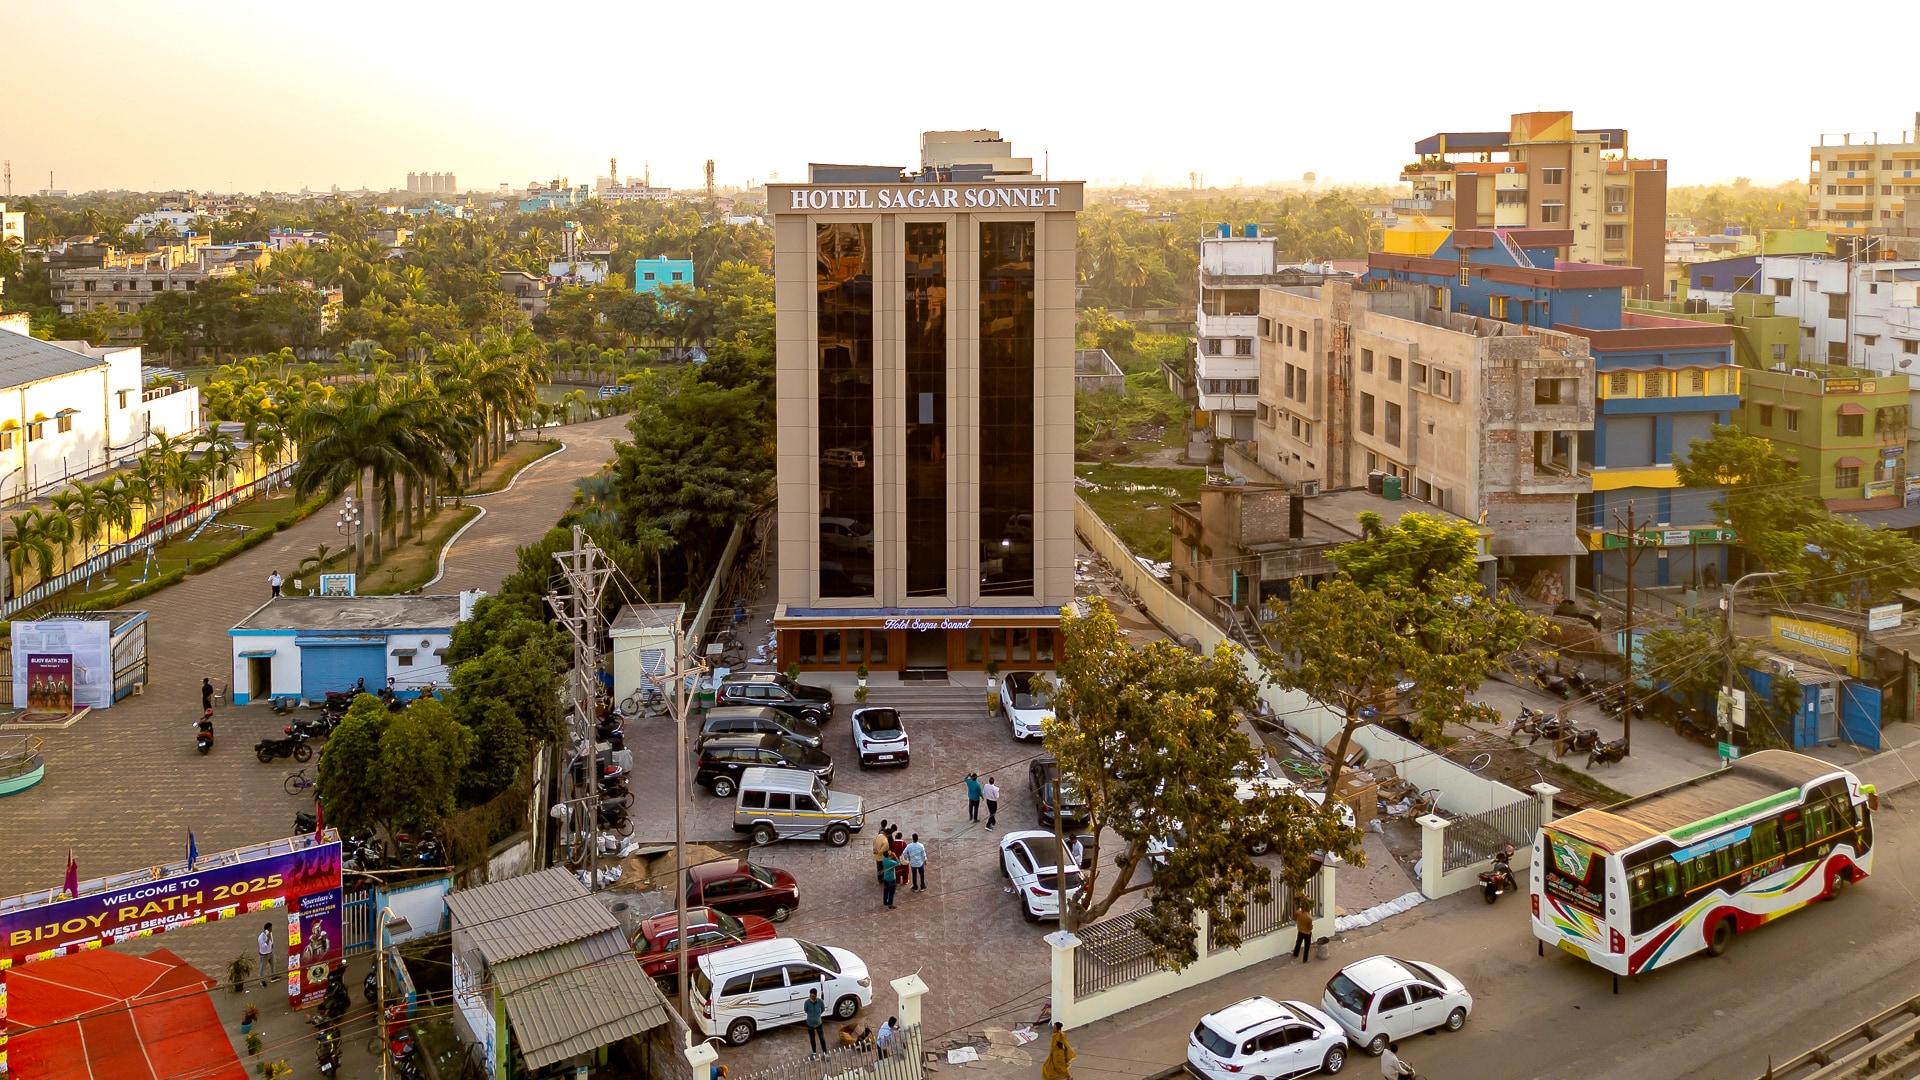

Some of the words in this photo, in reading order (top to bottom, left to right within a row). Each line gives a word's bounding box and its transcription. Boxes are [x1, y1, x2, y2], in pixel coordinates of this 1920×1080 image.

[790, 190, 874, 209] HOTEL
[878, 187, 960, 208] SAGAR
[964, 187, 1060, 207] SONNET
[883, 618, 910, 630] Hotel
[911, 617, 938, 632] Sagar
[940, 617, 972, 630] Sonnet
[103, 882, 177, 907] WELCOME
[180, 878, 200, 891] TO
[300, 892, 334, 908] Spartan's
[9, 911, 109, 947] BIJOY
[118, 890, 203, 923] RATH
[212, 873, 284, 901] 2025
[100, 923, 137, 939] WEST
[140, 911, 192, 930] BENGAL
[193, 908, 202, 918] 3
